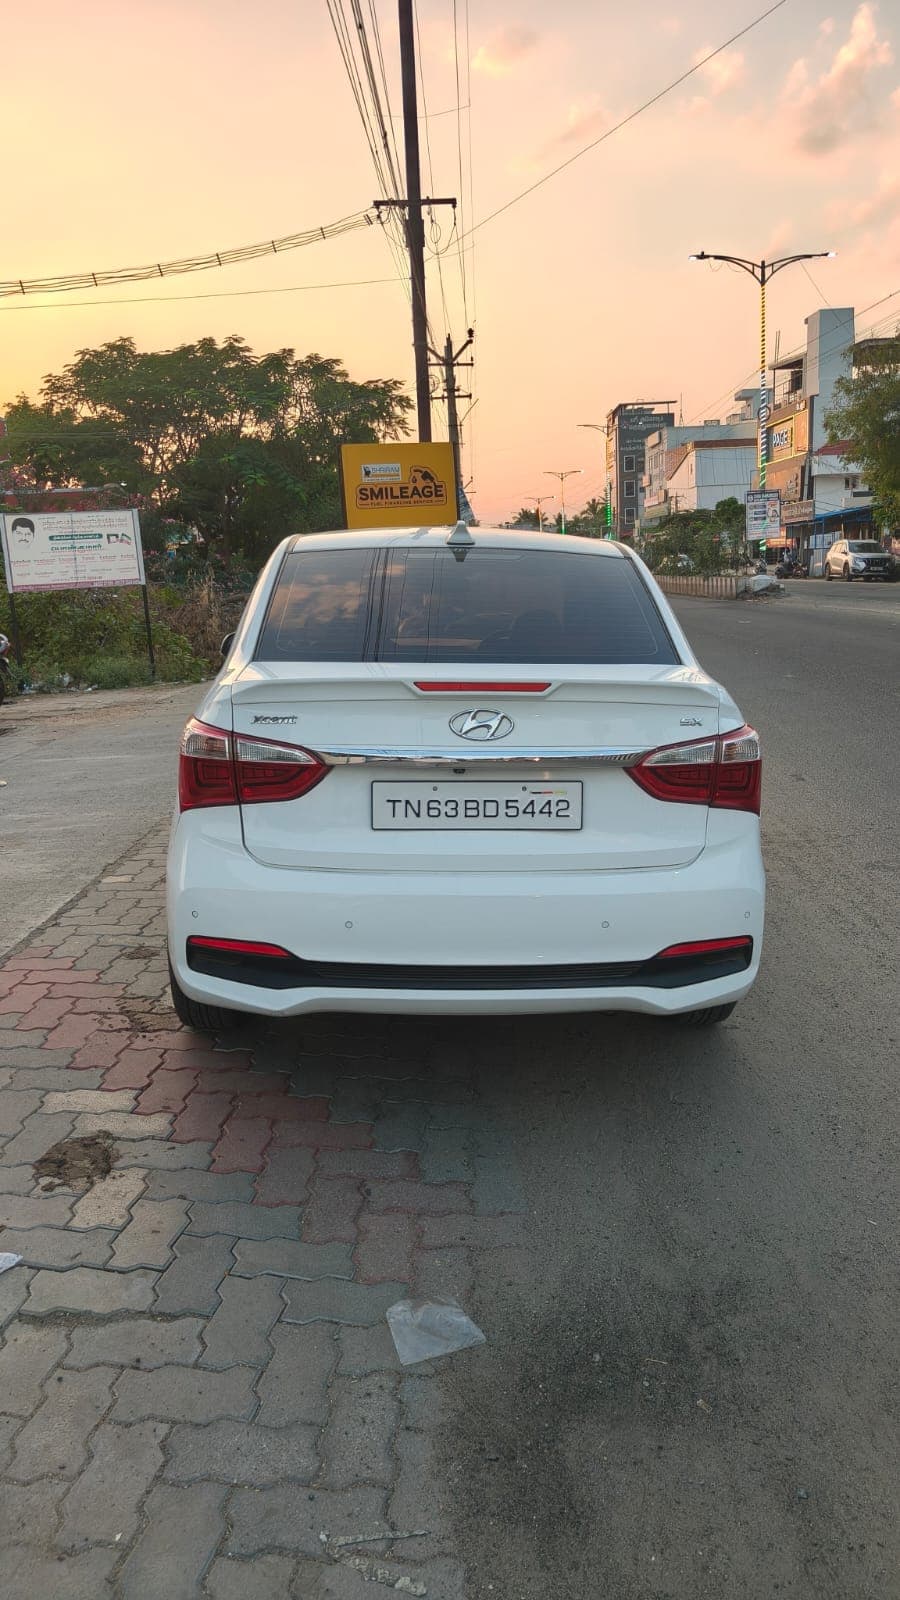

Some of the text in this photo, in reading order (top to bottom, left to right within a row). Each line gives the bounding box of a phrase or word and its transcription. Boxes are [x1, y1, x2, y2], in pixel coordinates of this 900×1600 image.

[359, 485, 443, 500] SMILEAGE
[252, 715, 298, 725] Xcent
[386, 799, 570, 818] TN63BD5442
